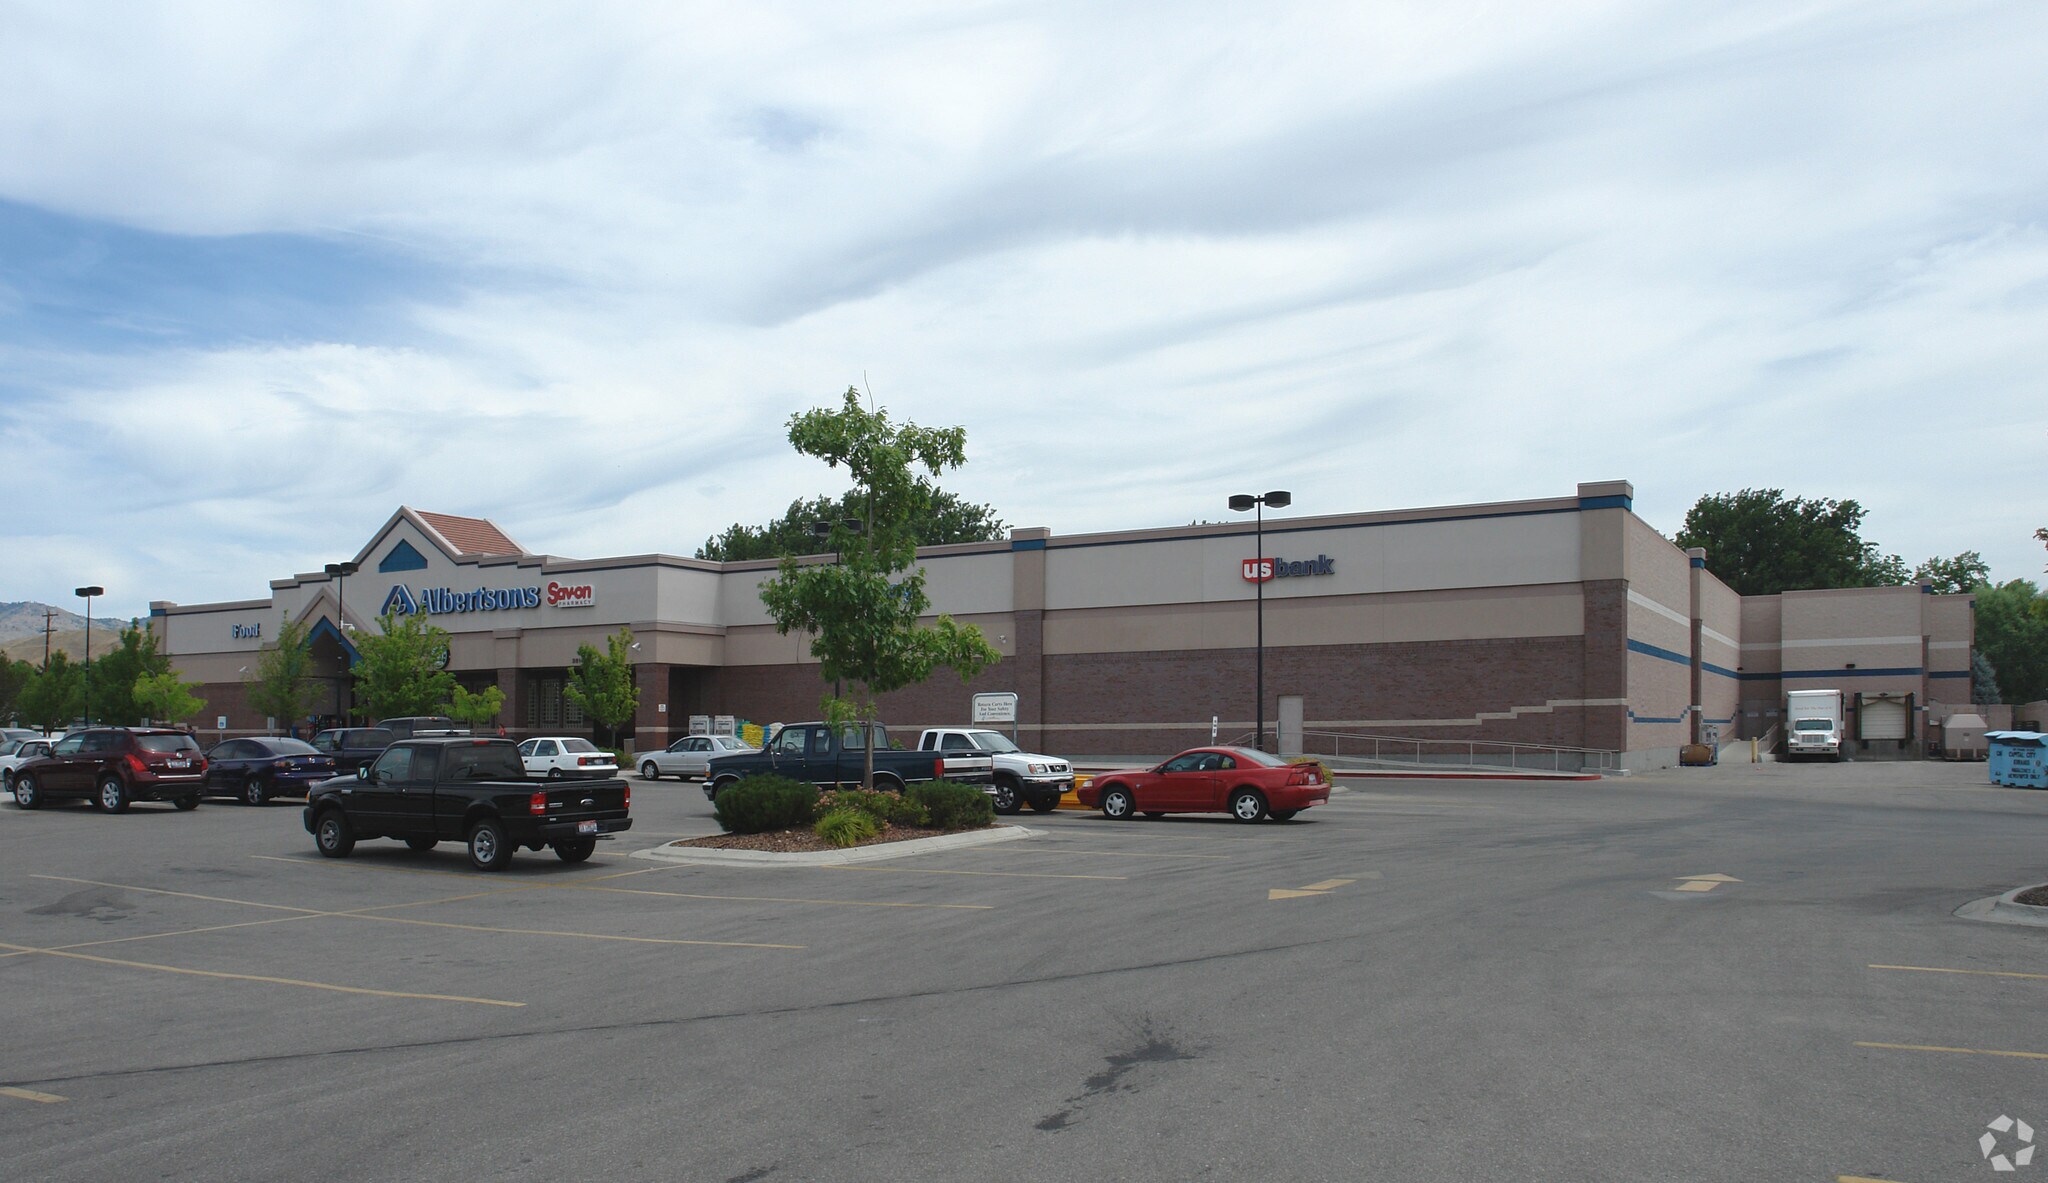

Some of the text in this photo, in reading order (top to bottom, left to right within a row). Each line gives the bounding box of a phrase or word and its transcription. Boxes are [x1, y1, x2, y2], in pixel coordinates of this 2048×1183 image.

[1243, 555, 1335, 579] us bank
[420, 586, 542, 615] Albertsons
[232, 622, 260, 639] Food
